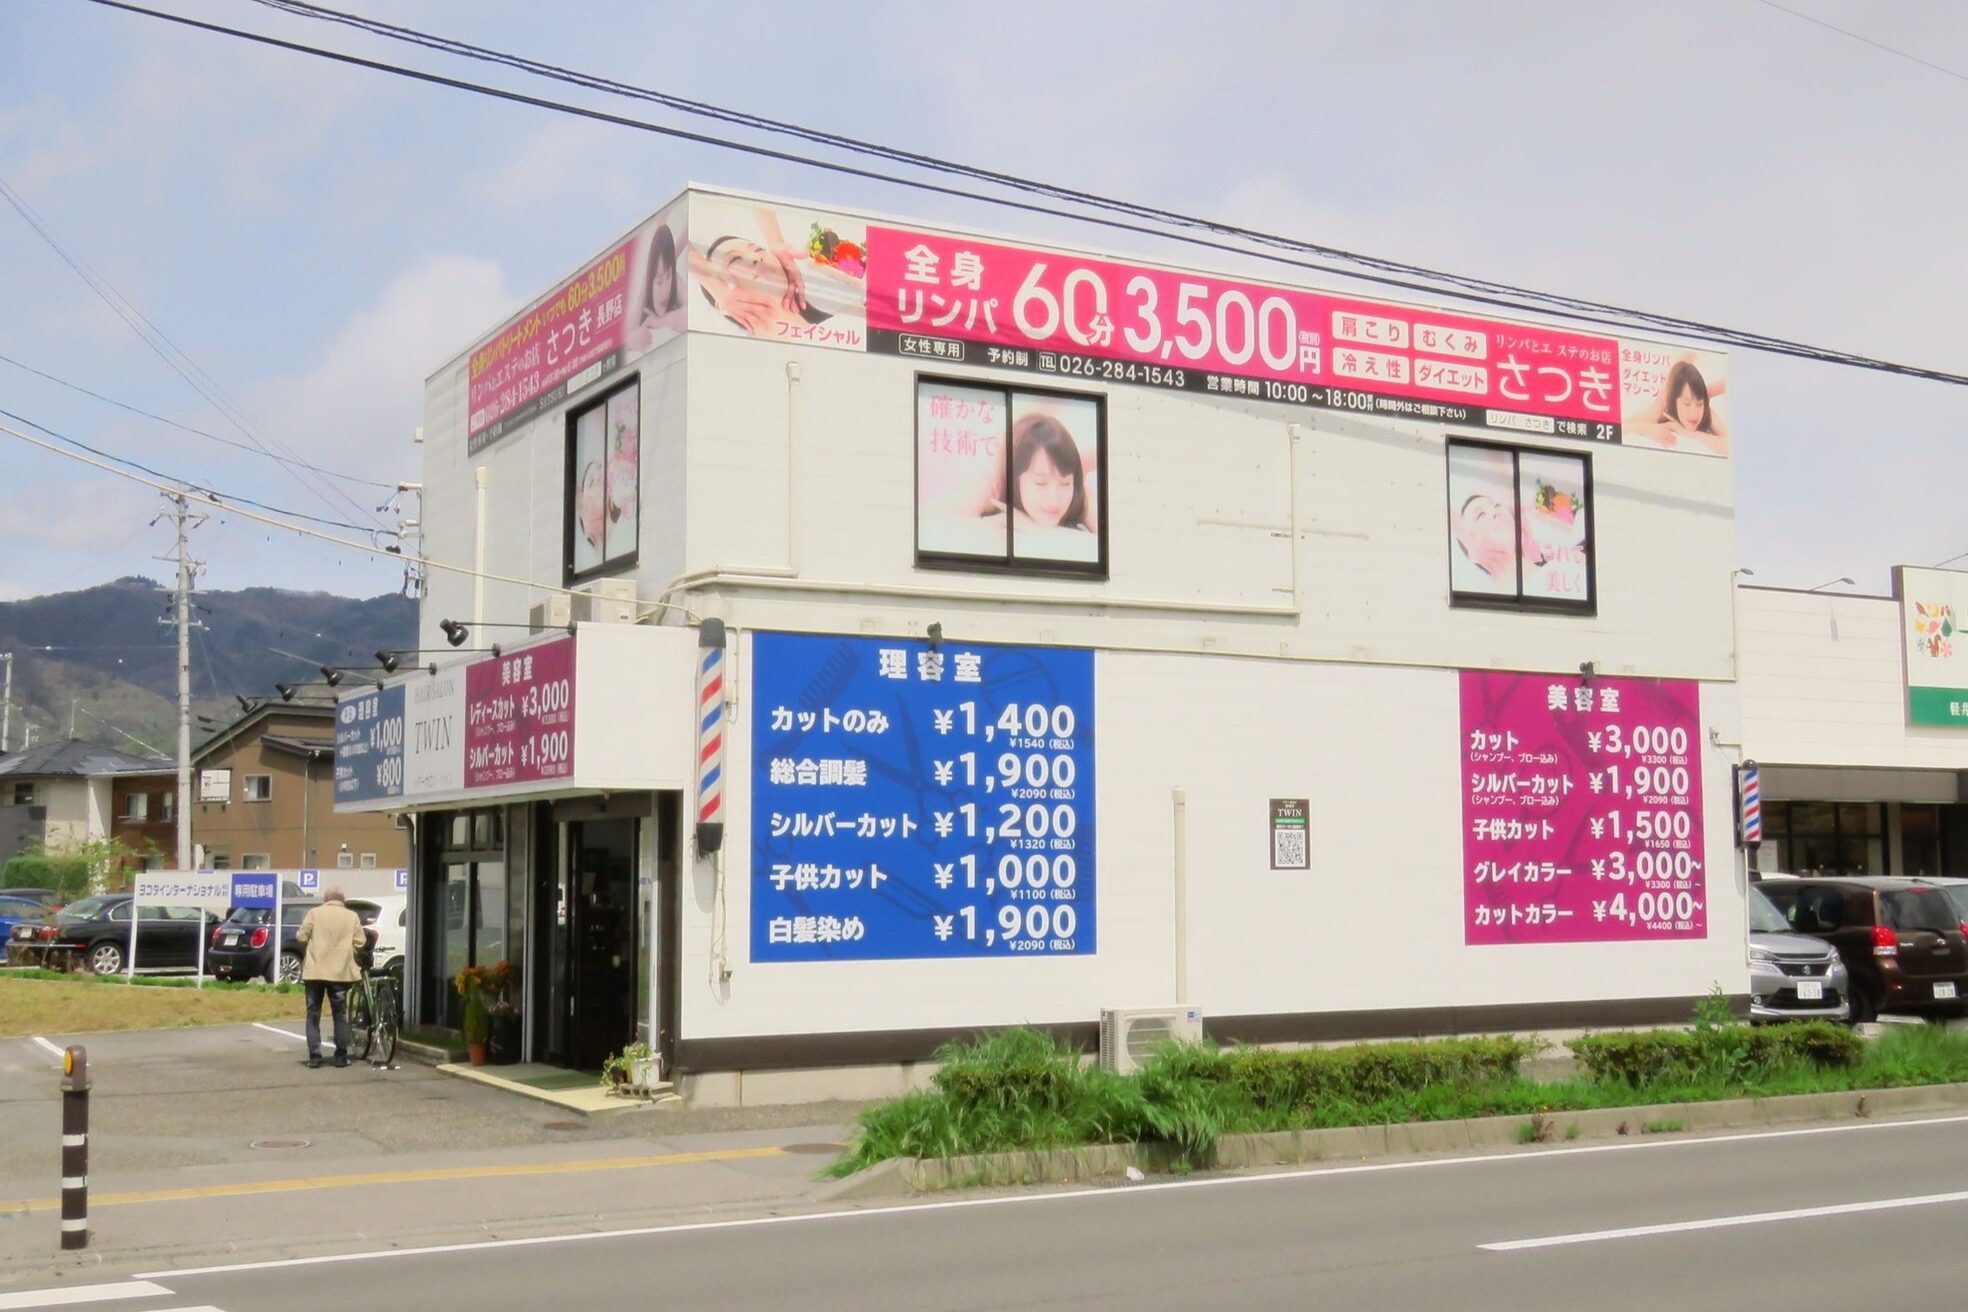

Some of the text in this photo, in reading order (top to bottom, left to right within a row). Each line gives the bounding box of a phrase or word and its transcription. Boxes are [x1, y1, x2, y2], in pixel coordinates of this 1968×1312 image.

[904, 243, 985, 290] 全身
[898, 288, 999, 334] リンパ
[547, 308, 591, 365] さつき
[775, 321, 861, 347] フェイシャル
[1341, 316, 1478, 353] 肩こり むくみ
[903, 337, 961, 358] 女性専用
[987, 347, 1029, 367] 予約制
[1060, 355, 1185, 387] 026-284-1543
[1207, 375, 1260, 396] 営業時間
[1265, 381, 1308, 403] 10:00
[1342, 352, 1485, 390] 冷え性 ダイエット
[1622, 348, 1671, 368] 全身リンパ
[1496, 354, 1614, 412] さつき
[1623, 368, 1668, 384] ダイエット
[1623, 382, 1661, 398] マシーン
[930, 394, 995, 424] 確かな
[930, 427, 999, 457] 技術で
[1556, 421, 1588, 437] で検索
[1596, 424, 1614, 441] 2F
[879, 649, 981, 682] 理容室
[470, 679, 569, 725] レディースカット ¥3,000
[1548, 685, 1620, 712] 美容室
[370, 716, 402, 752] ¥1,000
[415, 716, 452, 754] TWIN
[771, 701, 1075, 742] カットのみ ¥1,400
[470, 730, 568, 770] シルバーカット ¥1,900
[1009, 738, 1045, 749] ¥1540
[1471, 725, 1687, 759] カット ¥3,000
[377, 757, 401, 787] ¥800
[770, 752, 1075, 793] 総合調髪 ¥1,900
[1642, 755, 1666, 764] ¥3300
[1011, 788, 1046, 799] ¥2090
[1472, 766, 1689, 800] シルバーカット ¥1,900
[1277, 808, 1302, 817] TWIN
[1643, 796, 1667, 804] ¥2090
[770, 803, 1075, 843] シルバーカット ¥1,200
[1473, 811, 1690, 844] 子供カット ¥1,500
[1010, 839, 1045, 849] ¥1320
[1645, 840, 1670, 848] ¥1650
[770, 854, 1075, 895] 子供カット ¥1,000
[1474, 862, 1572, 883] グレイカラー
[1645, 881, 1670, 889] ¥3300
[139, 883, 222, 897] ヨコタインターナショナル
[234, 884, 274, 898] 専用駐車場
[1011, 890, 1046, 900] ¥1100
[770, 905, 1075, 946] 白髪染め ¥1,900
[1475, 904, 1573, 925] カットカラー
[1647, 922, 1672, 930] ¥4400
[1009, 940, 1045, 951] ¥2090
